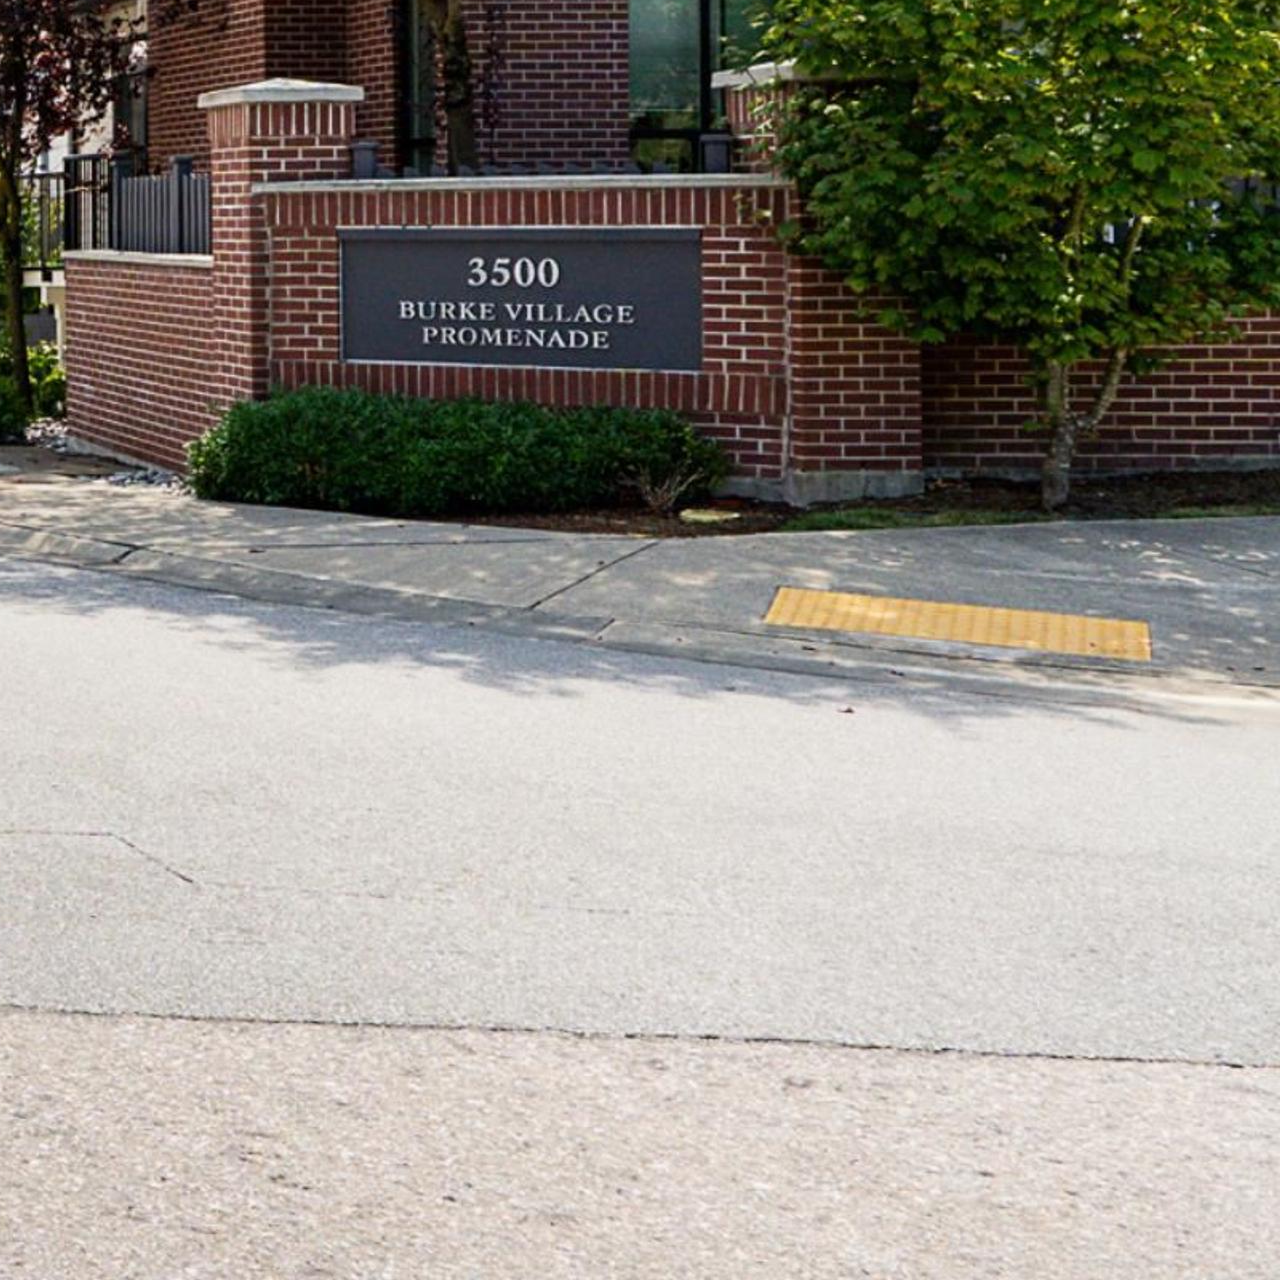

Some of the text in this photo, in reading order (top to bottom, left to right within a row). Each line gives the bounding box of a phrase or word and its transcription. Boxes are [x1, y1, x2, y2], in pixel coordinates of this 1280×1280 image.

[466, 256, 561, 288] 3500
[398, 299, 635, 325] BURKE VILLAGE
[421, 325, 610, 350] PROMENADE
